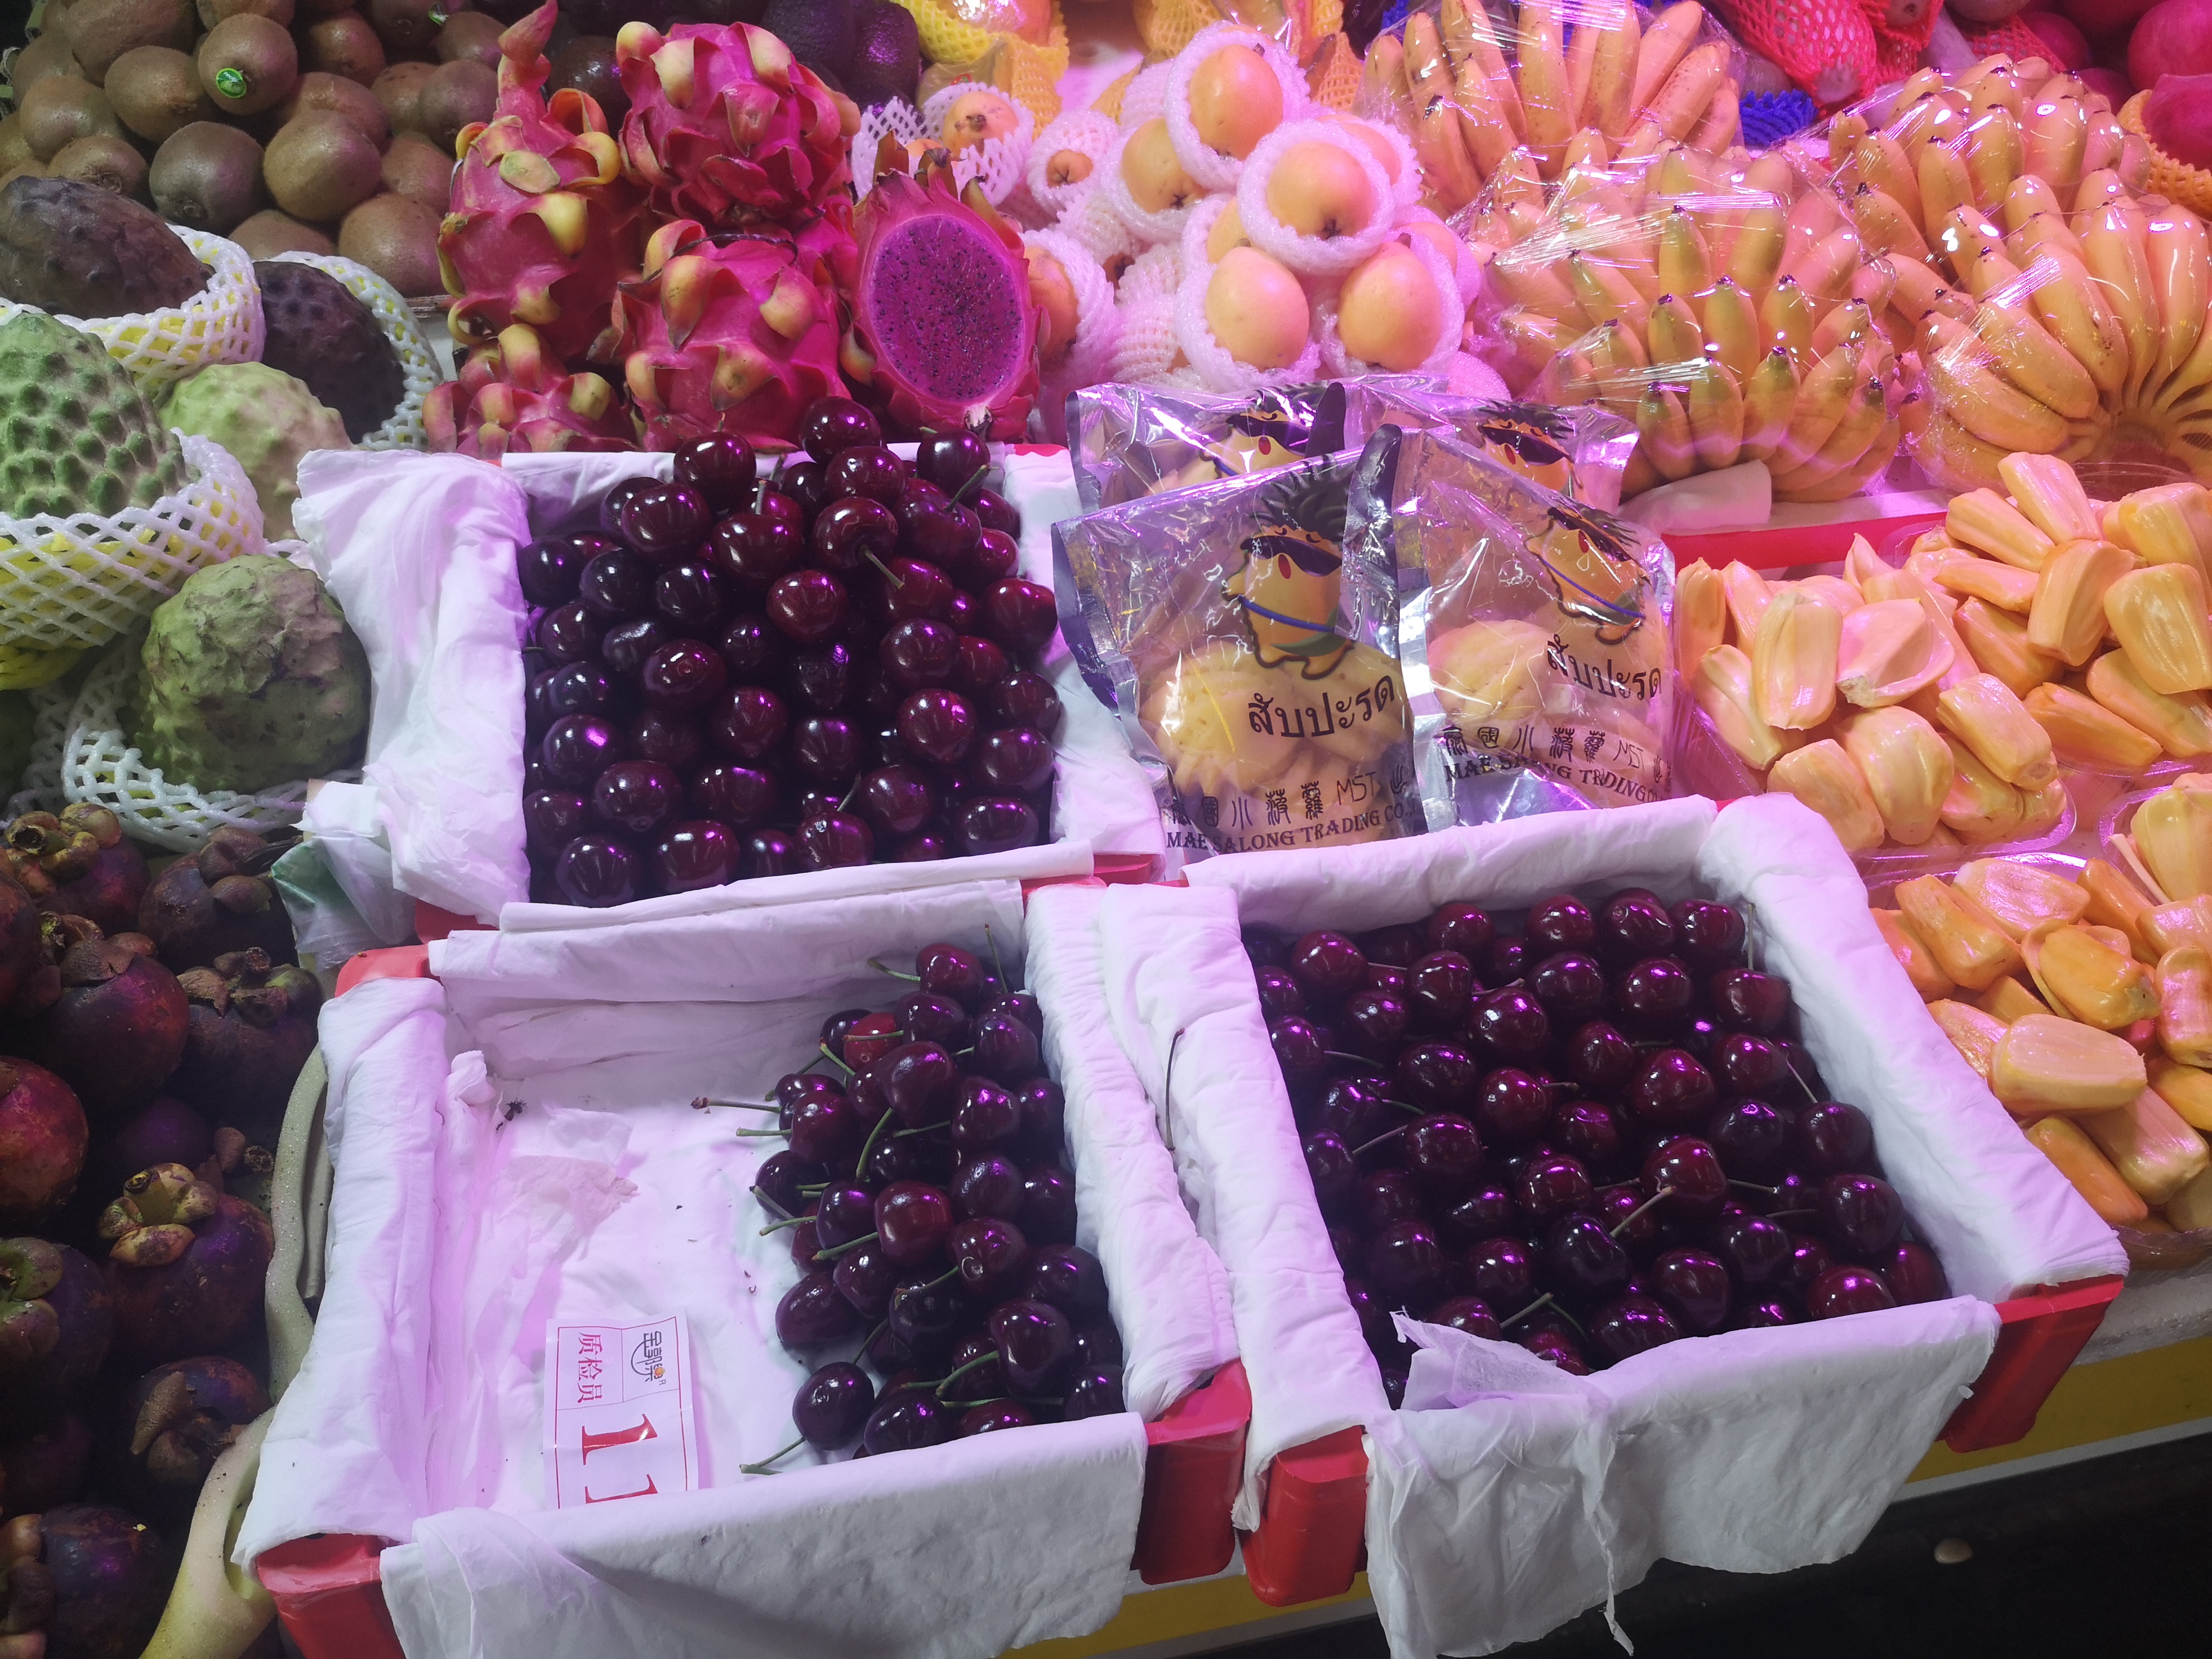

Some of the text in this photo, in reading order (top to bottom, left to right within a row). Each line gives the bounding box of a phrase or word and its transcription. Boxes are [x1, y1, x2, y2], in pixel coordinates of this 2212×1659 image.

[1547, 633, 1662, 700] สับปะรด
[1248, 675, 1395, 738] สับปะรด
[1337, 772, 1376, 806] MST
[1167, 832, 1209, 850] MAE
[1213, 831, 1295, 854] SALONG
[1301, 809, 1381, 842] TRADING
[578, 1332, 603, 1403] 质检员
